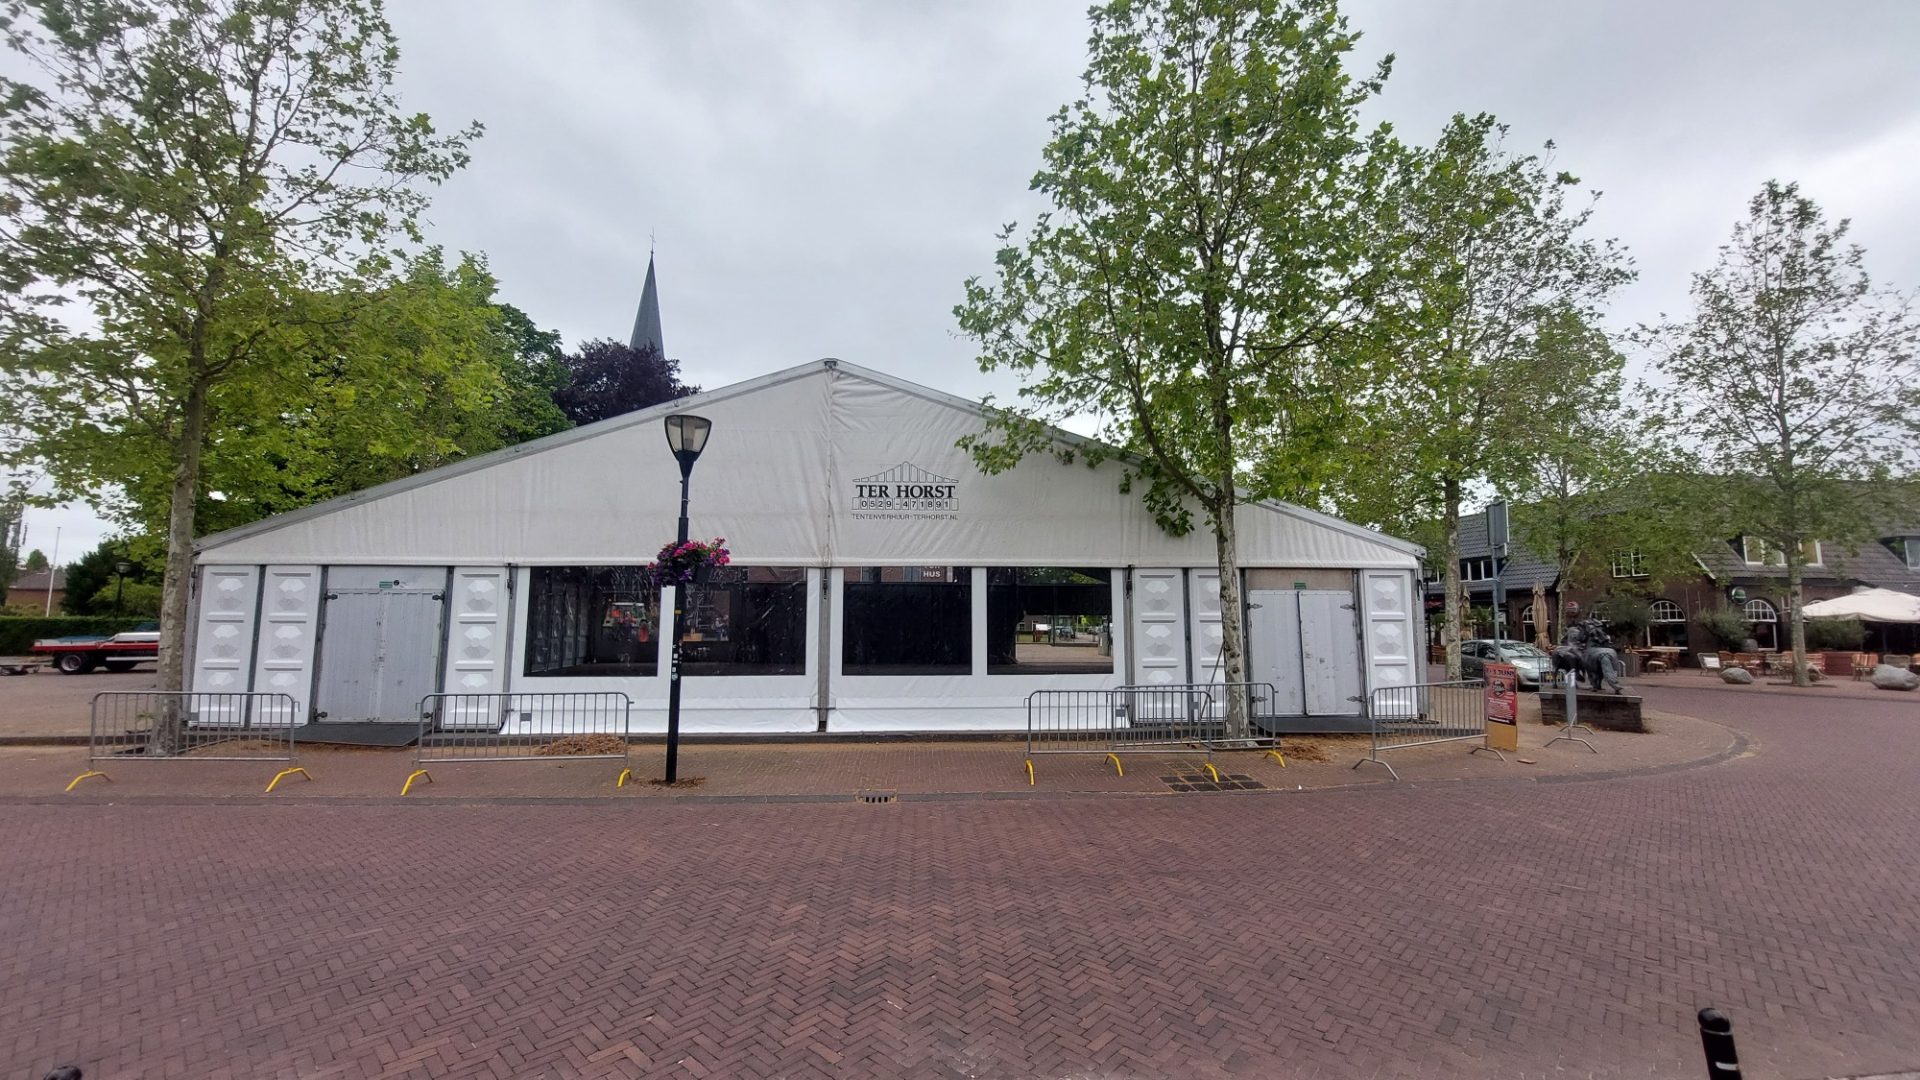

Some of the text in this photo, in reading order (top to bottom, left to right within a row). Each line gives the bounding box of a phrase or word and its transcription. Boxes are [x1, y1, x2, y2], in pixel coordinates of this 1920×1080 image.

[856, 484, 956, 498] TER HORST
[861, 500, 950, 508] 0529-471891
[923, 570, 941, 578] HUS
